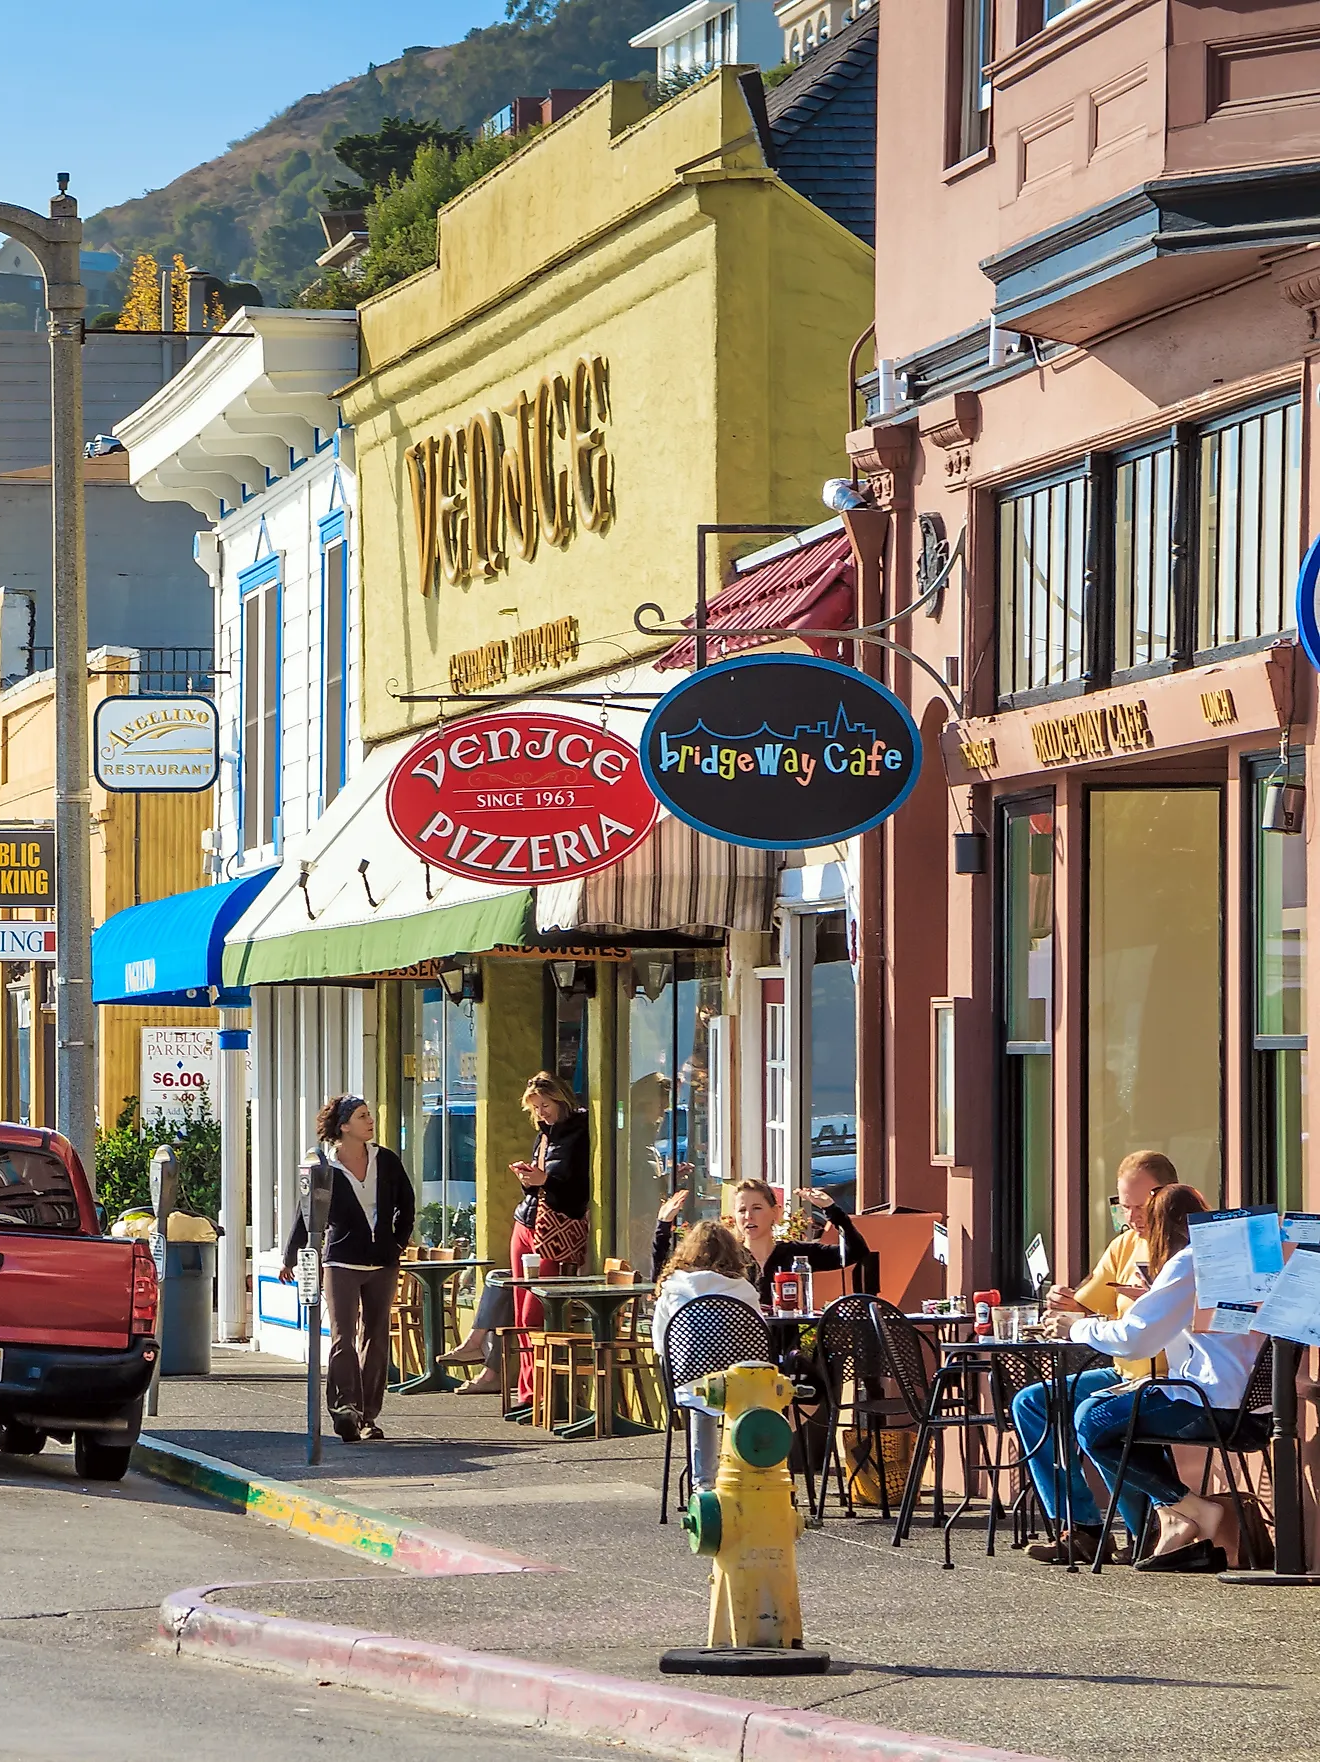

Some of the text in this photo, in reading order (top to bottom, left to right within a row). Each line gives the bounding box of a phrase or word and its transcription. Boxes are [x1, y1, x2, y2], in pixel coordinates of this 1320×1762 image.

[404, 352, 606, 599] VENICE
[101, 709, 209, 760] ANGELINO
[1031, 708, 1106, 763] BRIDGEWAY
[1108, 701, 1148, 747] CAFE
[1200, 689, 1233, 723] LUNCH
[104, 764, 212, 775] RESTAURANT
[411, 727, 630, 788] VENICE
[823, 741, 902, 776] Cafe
[476, 790, 575, 808] SINCE 1963
[419, 811, 635, 873] PIZZERIA
[147, 1044, 213, 1056] PARKING
[156, 1031, 205, 1043] PUBLIC
[153, 1072, 205, 1087] $6.00
